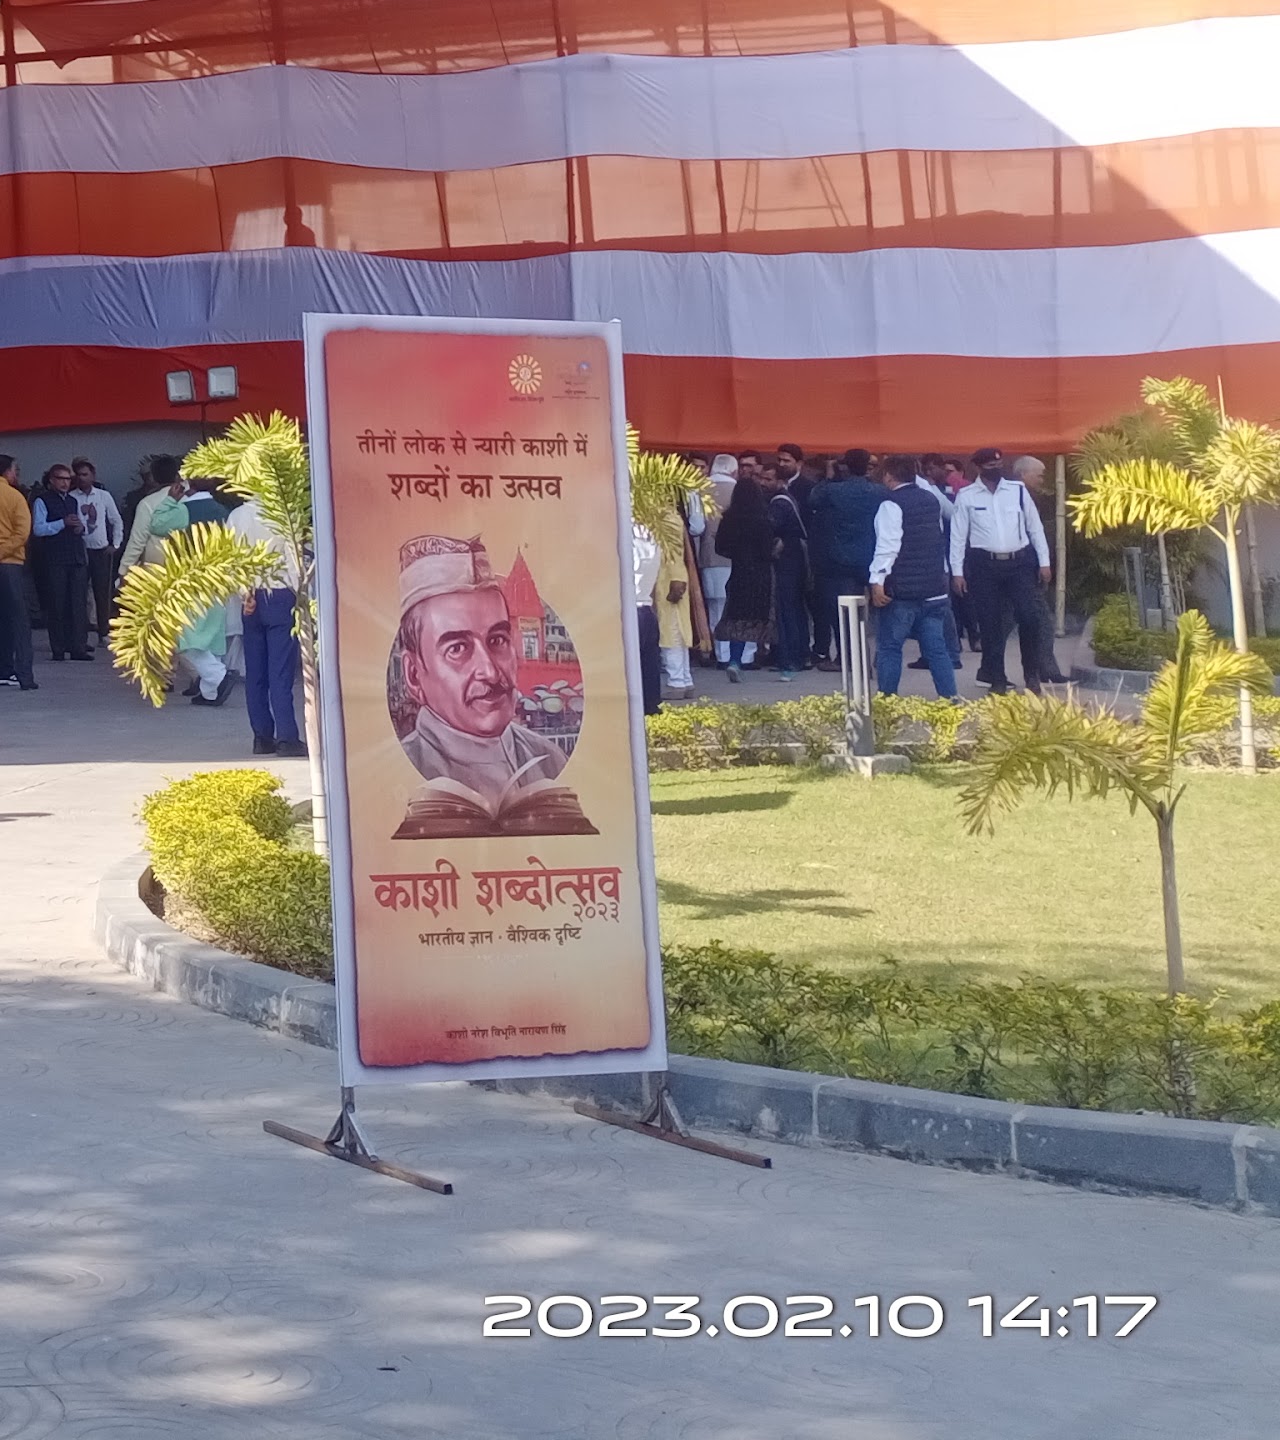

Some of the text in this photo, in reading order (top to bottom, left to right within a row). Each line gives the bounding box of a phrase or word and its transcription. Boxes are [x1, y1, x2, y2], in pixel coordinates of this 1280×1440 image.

[356, 428, 588, 458] तीनों लोक से न्यारी काशी में
[387, 464, 563, 502] शब्दों का उत्सव
[369, 855, 623, 918] काशी शब्दोत्सव
[572, 901, 620, 923] २०२३
[418, 923, 582, 947] भारतीय ज्ञान वैश्विक दृष्टि
